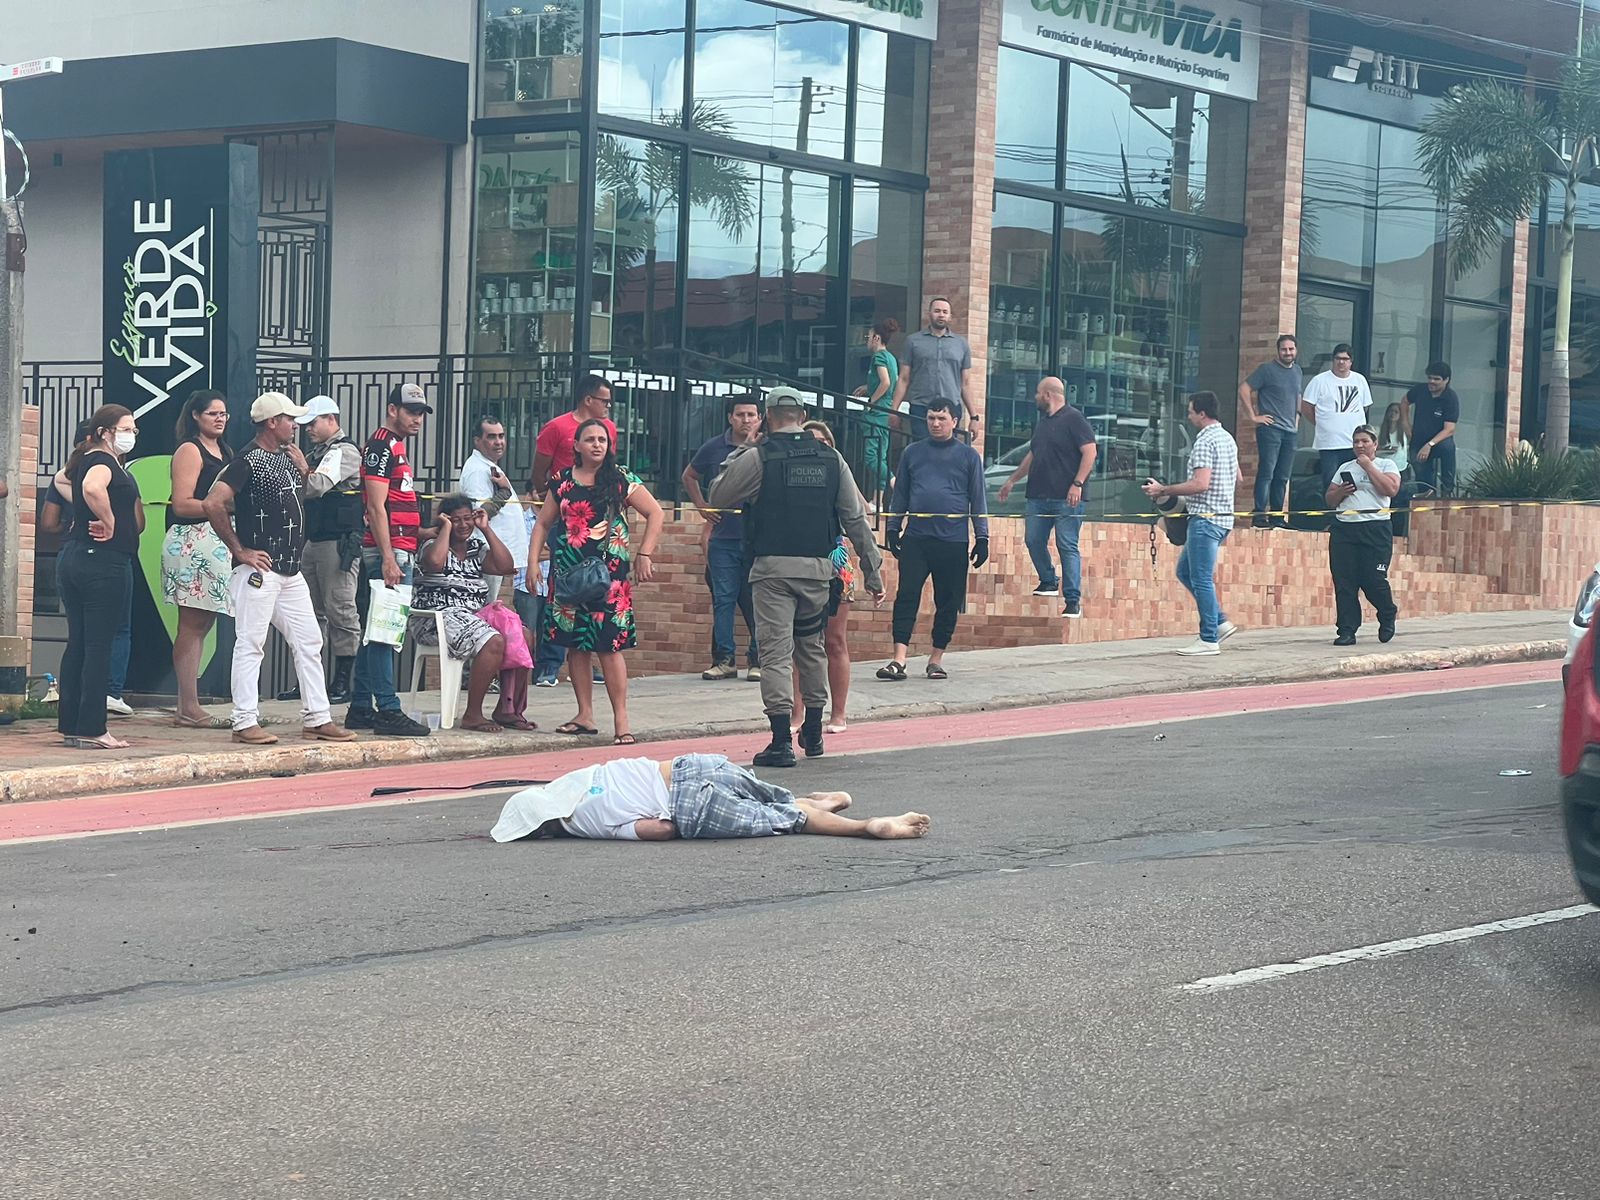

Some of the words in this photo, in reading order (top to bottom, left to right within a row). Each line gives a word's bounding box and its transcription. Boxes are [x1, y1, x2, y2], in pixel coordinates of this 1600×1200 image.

[1031, 0, 1242, 62] NTEMVIDA
[1037, 25, 1079, 46] Farmácia
[1080, 36, 1092, 49] de
[1093, 40, 1148, 62] Manipulação
[1149, 55, 1155, 64] e
[1156, 55, 1191, 73] Nutrição
[1193, 64, 1230, 82] Esportiva
[1374, 53, 1419, 90] SEAX
[110, 256, 146, 367] Espaço
[133, 198, 172, 421] VERDE
[166, 225, 205, 392] VIDA
[377, 448, 391, 477] HAVAN
